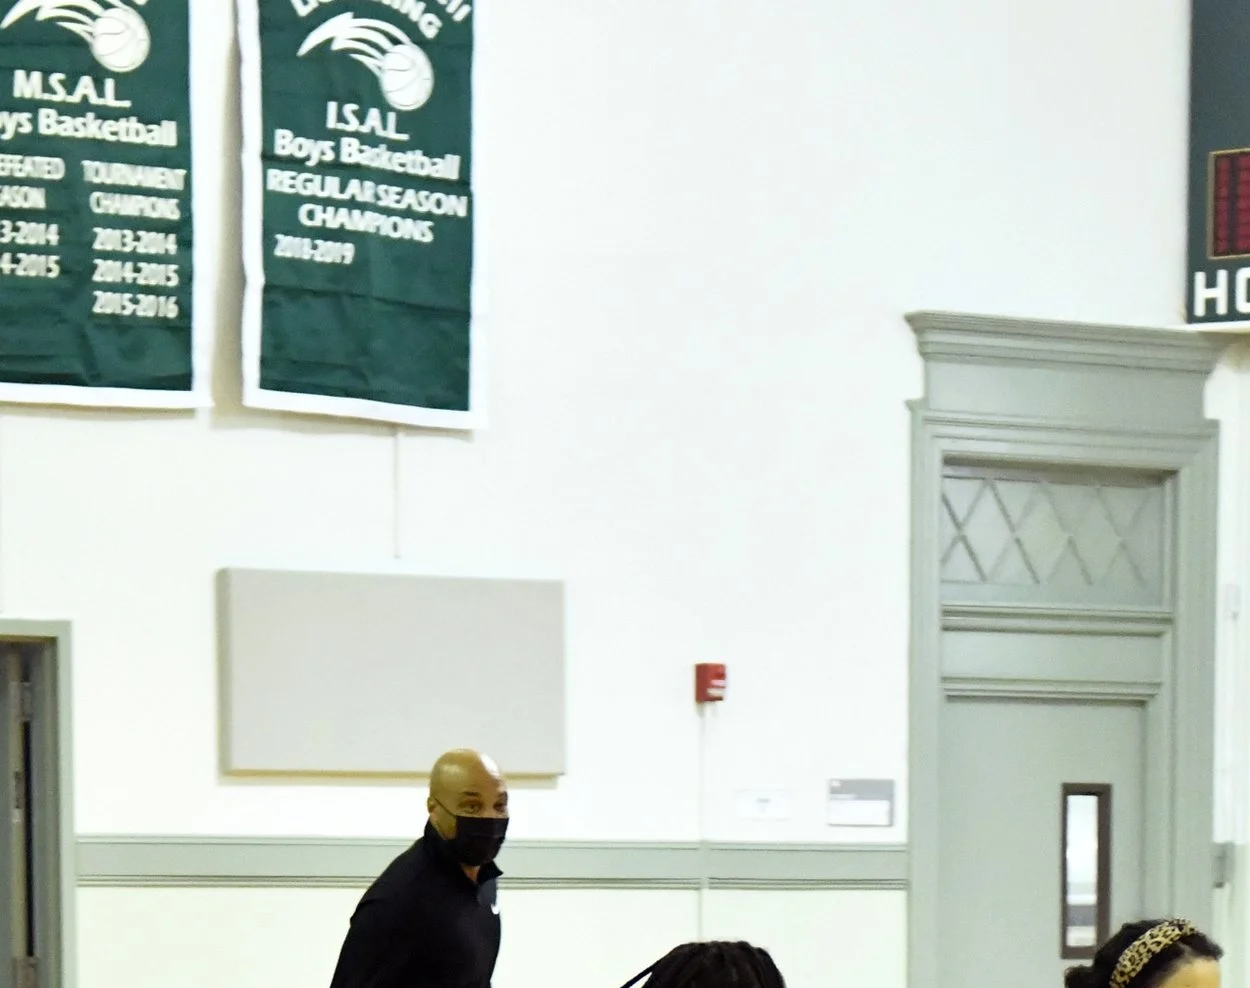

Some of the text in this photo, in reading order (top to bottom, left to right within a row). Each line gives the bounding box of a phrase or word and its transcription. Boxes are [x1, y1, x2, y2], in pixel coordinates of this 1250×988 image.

[0, 108, 178, 147] ys Basketball
[274, 128, 461, 180] Boys Basketball
[80, 160, 187, 191] TOURNAMENT
[0, 185, 46, 209] ASON
[89, 191, 181, 220] CHAMPIONS
[266, 168, 468, 217] REGULAR SEASON
[298, 203, 434, 243] CHAMPIONS
[92, 227, 178, 255] 2013-2014
[92, 259, 179, 287] 2014-2015
[92, 290, 179, 319] 2015-2016
